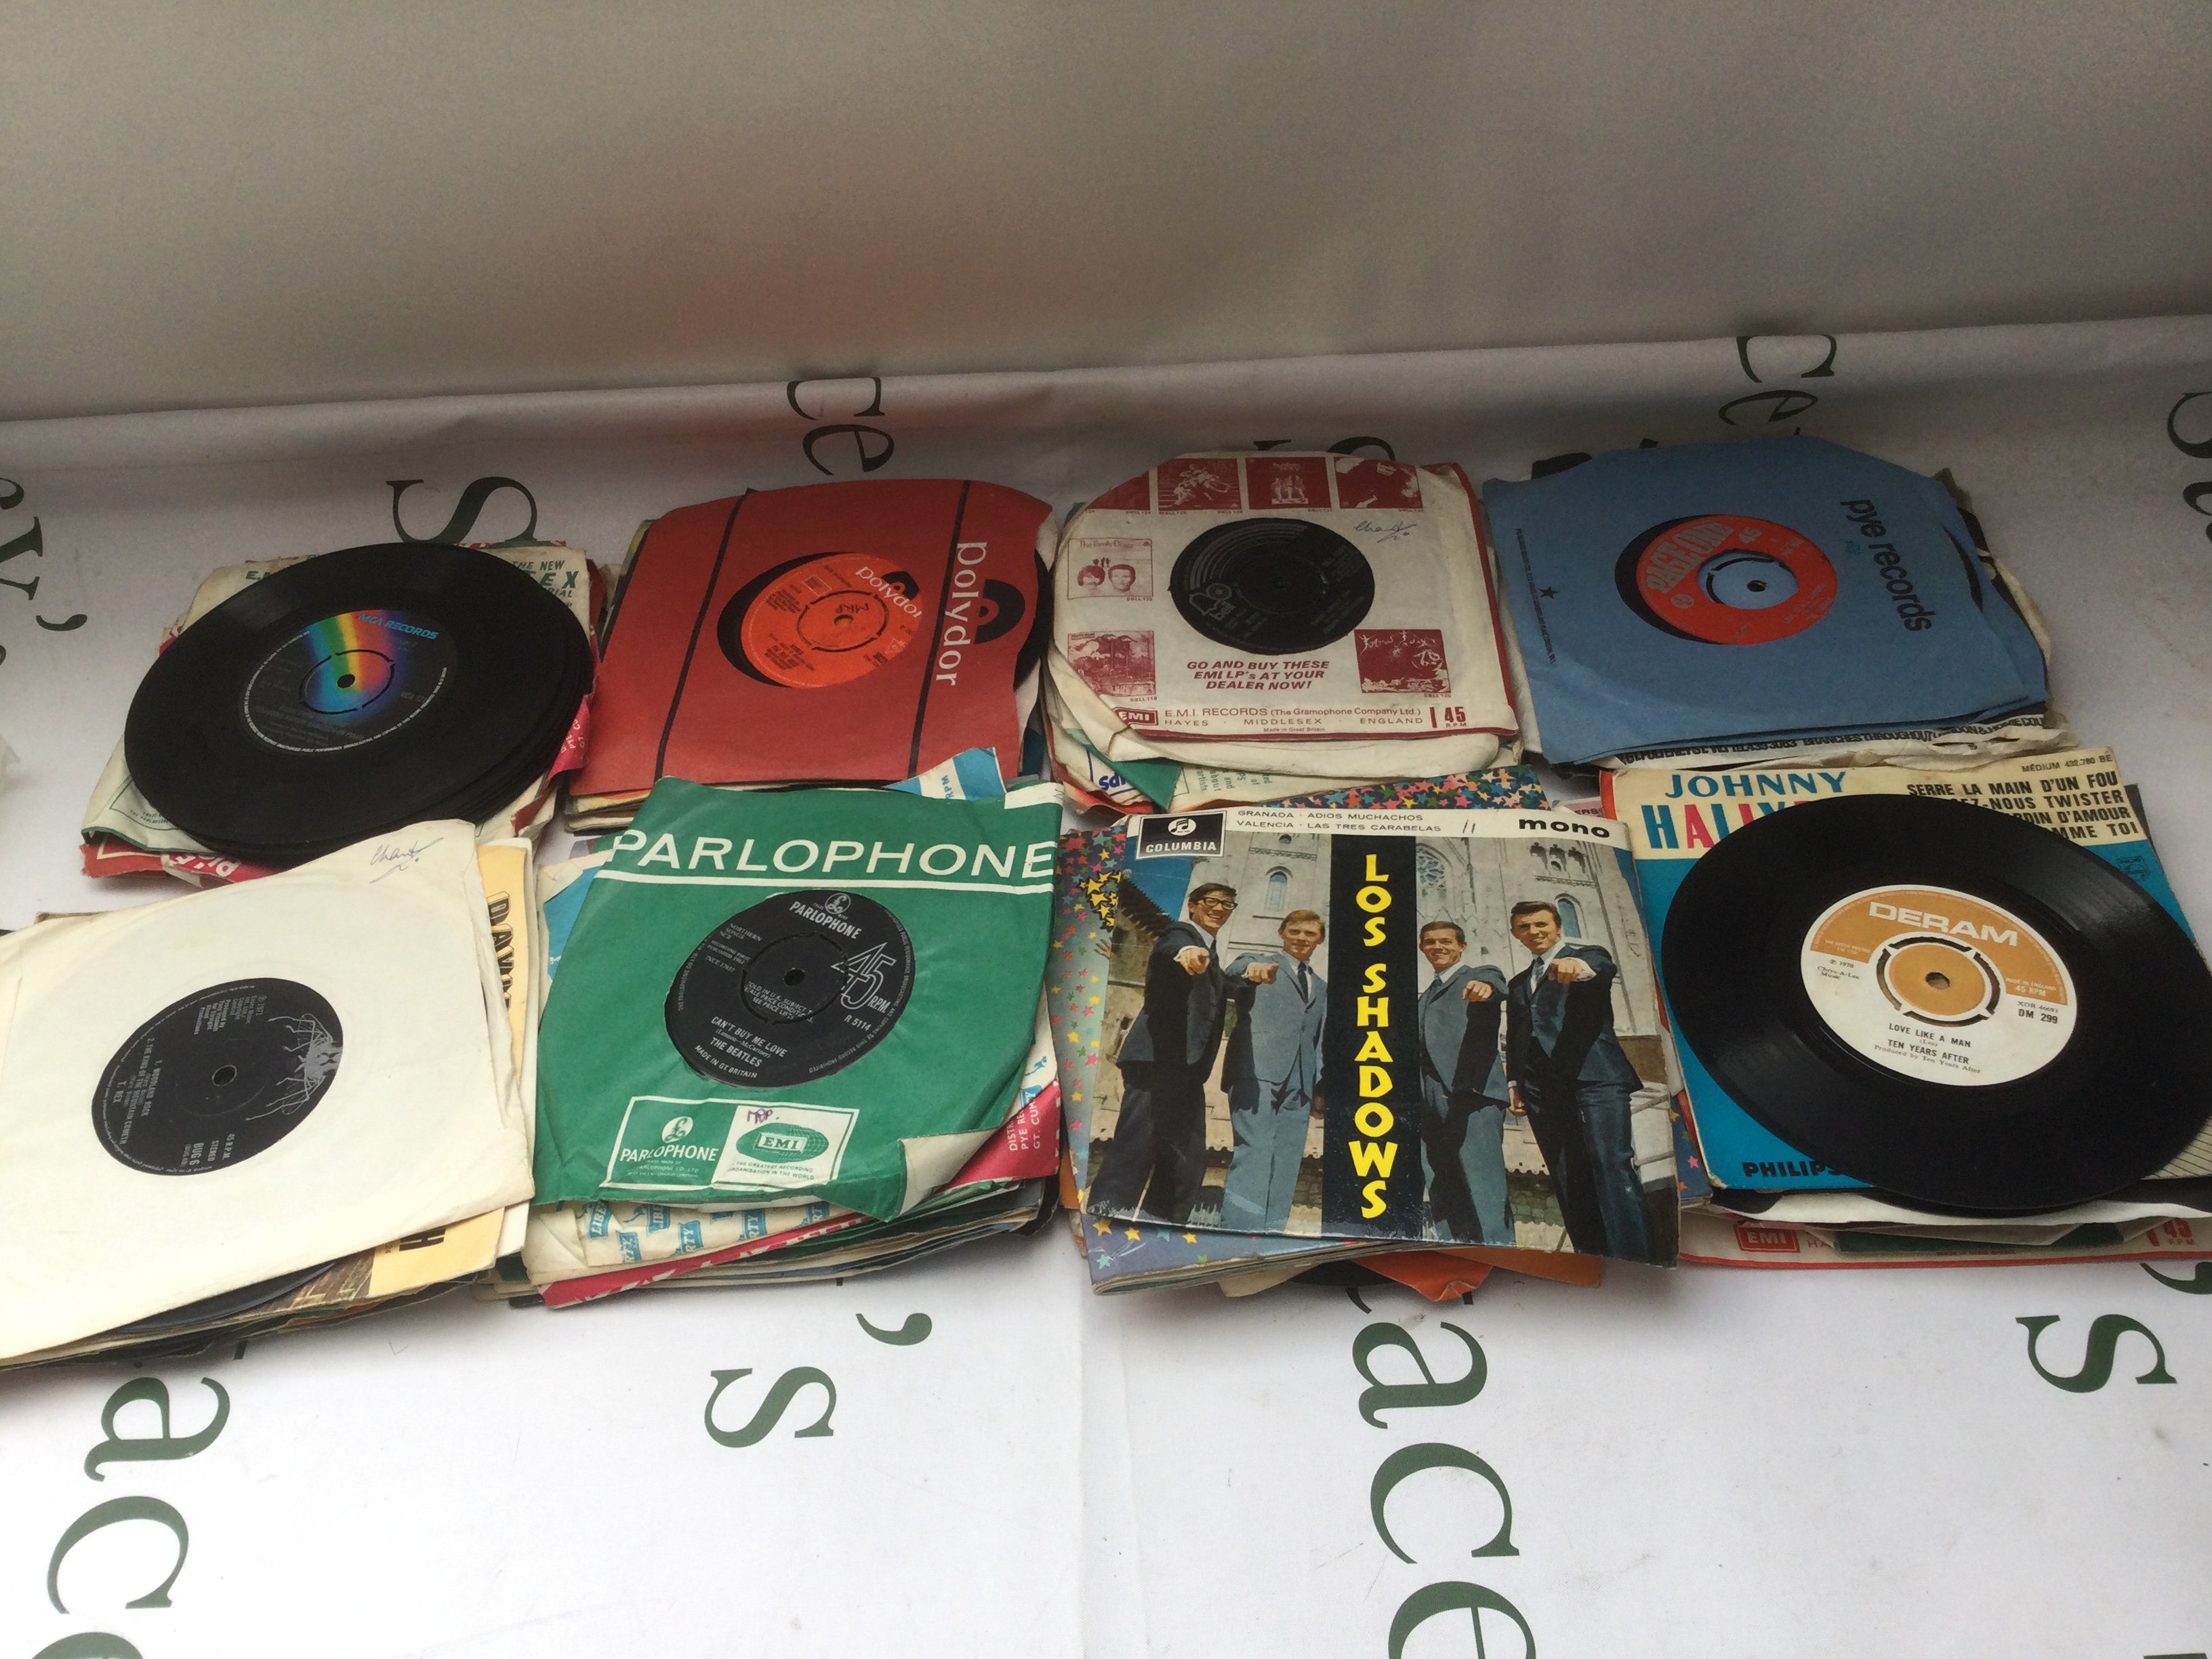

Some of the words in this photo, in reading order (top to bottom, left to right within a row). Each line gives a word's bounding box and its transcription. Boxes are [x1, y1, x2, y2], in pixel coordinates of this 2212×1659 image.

[541, 560, 565, 571] NEW
[1645, 540, 1705, 595] PAGE
[1840, 499, 1887, 537] pye
[1868, 544, 1936, 631] records
[855, 566, 923, 618] polydor
[936, 541, 987, 687] polydor
[359, 613, 381, 626] MCA
[385, 619, 439, 640] RECORDS
[1187, 661, 1208, 670] GO
[1211, 661, 1244, 670] AND
[1248, 661, 1278, 670] BUY
[1282, 660, 1330, 669] THESE
[1193, 671, 1223, 679] EMI
[1259, 672, 1281, 680] AT
[1285, 670, 1325, 678] YOUR
[1206, 680, 1265, 690] DEALER
[1267, 680, 1312, 690] NOW!
[1119, 711, 1150, 721] EMI
[1165, 709, 1198, 717] E.M.I.
[1202, 708, 1268, 716] RECORDS
[1271, 708, 1291, 717] (The
[1293, 708, 1352, 717] Gramophone
[1354, 707, 1397, 717] Company
[1444, 706, 1467, 723] 45
[1803, 734, 1862, 746] BRANCHES
[1863, 730, 1933, 743] THROUGHOUT
[2022, 762, 2060, 773] MÉDIUM
[2098, 754, 2113, 762] BE
[1225, 776, 1235, 790] and
[1665, 771, 1846, 799] JOHNNY
[1906, 783, 1954, 796] SERRE
[1962, 783, 1982, 795] LA
[1988, 781, 2032, 794] MAIN
[2041, 776, 2079, 793] D'UN
[2087, 771, 2118, 787] FOU
[2043, 790, 2125, 808] TWISTER
[1237, 810, 1294, 818] GRANADA
[1307, 812, 1343, 820] ADIOS
[1348, 813, 1424, 821] MUCHACHOS
[2057, 806, 2132, 823] D'AMOUR
[1237, 820, 1294, 828] VALENCIA
[1371, 824, 1441, 832] CARABELAS
[1519, 819, 1610, 838] mono
[2108, 821, 2139, 837] TOI
[607, 829, 1059, 880] PARLOPHONE
[1145, 841, 1217, 853] COLUMBIA
[1355, 854, 1393, 948] LOS
[789, 901, 863, 939] PARLOPHONE
[1869, 901, 2018, 947] DERAM
[726, 927, 745, 941] SONGS
[730, 922, 763, 942] NORTHERN
[831, 941, 897, 1010] 45
[2015, 985, 2027, 994] 45
[752, 996, 765, 1006] SEE
[764, 1001, 781, 1013] PRICE
[760, 993, 777, 1006] PRICE
[783, 997, 807, 1012] SUBJECT
[844, 1014, 853, 1023] R
[851, 1017, 872, 1031] 5114
[2018, 1008, 2034, 1019] DM
[2041, 1012, 2058, 1024] 299
[711, 1015, 736, 1033] CAN'T
[734, 1027, 754, 1041] BUY
[752, 1035, 766, 1047] ME
[765, 1042, 787, 1058] LOVE
[1889, 1023, 1910, 1035] LOVE
[1915, 1029, 1935, 1040] LIKE
[1939, 1035, 1946, 1043] A
[1951, 1037, 1971, 1048] MAN
[144, 1044, 153, 1054] THE
[710, 1037, 725, 1050] THE
[726, 1045, 762, 1067] BEATLES
[1875, 1044, 1907, 1057] Produced
[1910, 1052, 1919, 1061] by
[1922, 1055, 1936, 1064] Ten
[1939, 1059, 1959, 1069] Years
[1887, 1039, 1905, 1049] TEN
[1910, 1044, 1938, 1057] YEARS
[1942, 1052, 1969, 1065] AFTER
[140, 1054, 151, 1069] KING
[695, 1044, 712, 1061] MADE
[710, 1057, 718, 1067] IN
[718, 1062, 730, 1072] GT.
[729, 1066, 758, 1079] BRITAIN
[117, 1080, 127, 1088] T.
[146, 1067, 162, 1099] WOODLAND
[1351, 963, 1399, 1220] SHADOWS
[112, 1090, 125, 1104] REX
[126, 1089, 141, 1120] MOUNTAIN
[140, 1100, 152, 1118] ROCK
[119, 1120, 133, 1145] COMETH
[226, 1132, 236, 1141] 45
[1018, 1128, 1029, 1151] PYE
[1032, 1129, 1041, 1150] GT.
[190, 1142, 205, 1159] BUG
[207, 1140, 220, 1162] STEREO
[762, 1136, 799, 1151] EMI
[619, 1144, 719, 1162] PARLOPHONE
[779, 1164, 814, 1173] RECORDING
[790, 1172, 815, 1181] WORLD
[1742, 1161, 1842, 1179] PHILIPS
[2162, 1218, 2193, 1238] 45
[1746, 1230, 1788, 1245] EMI
